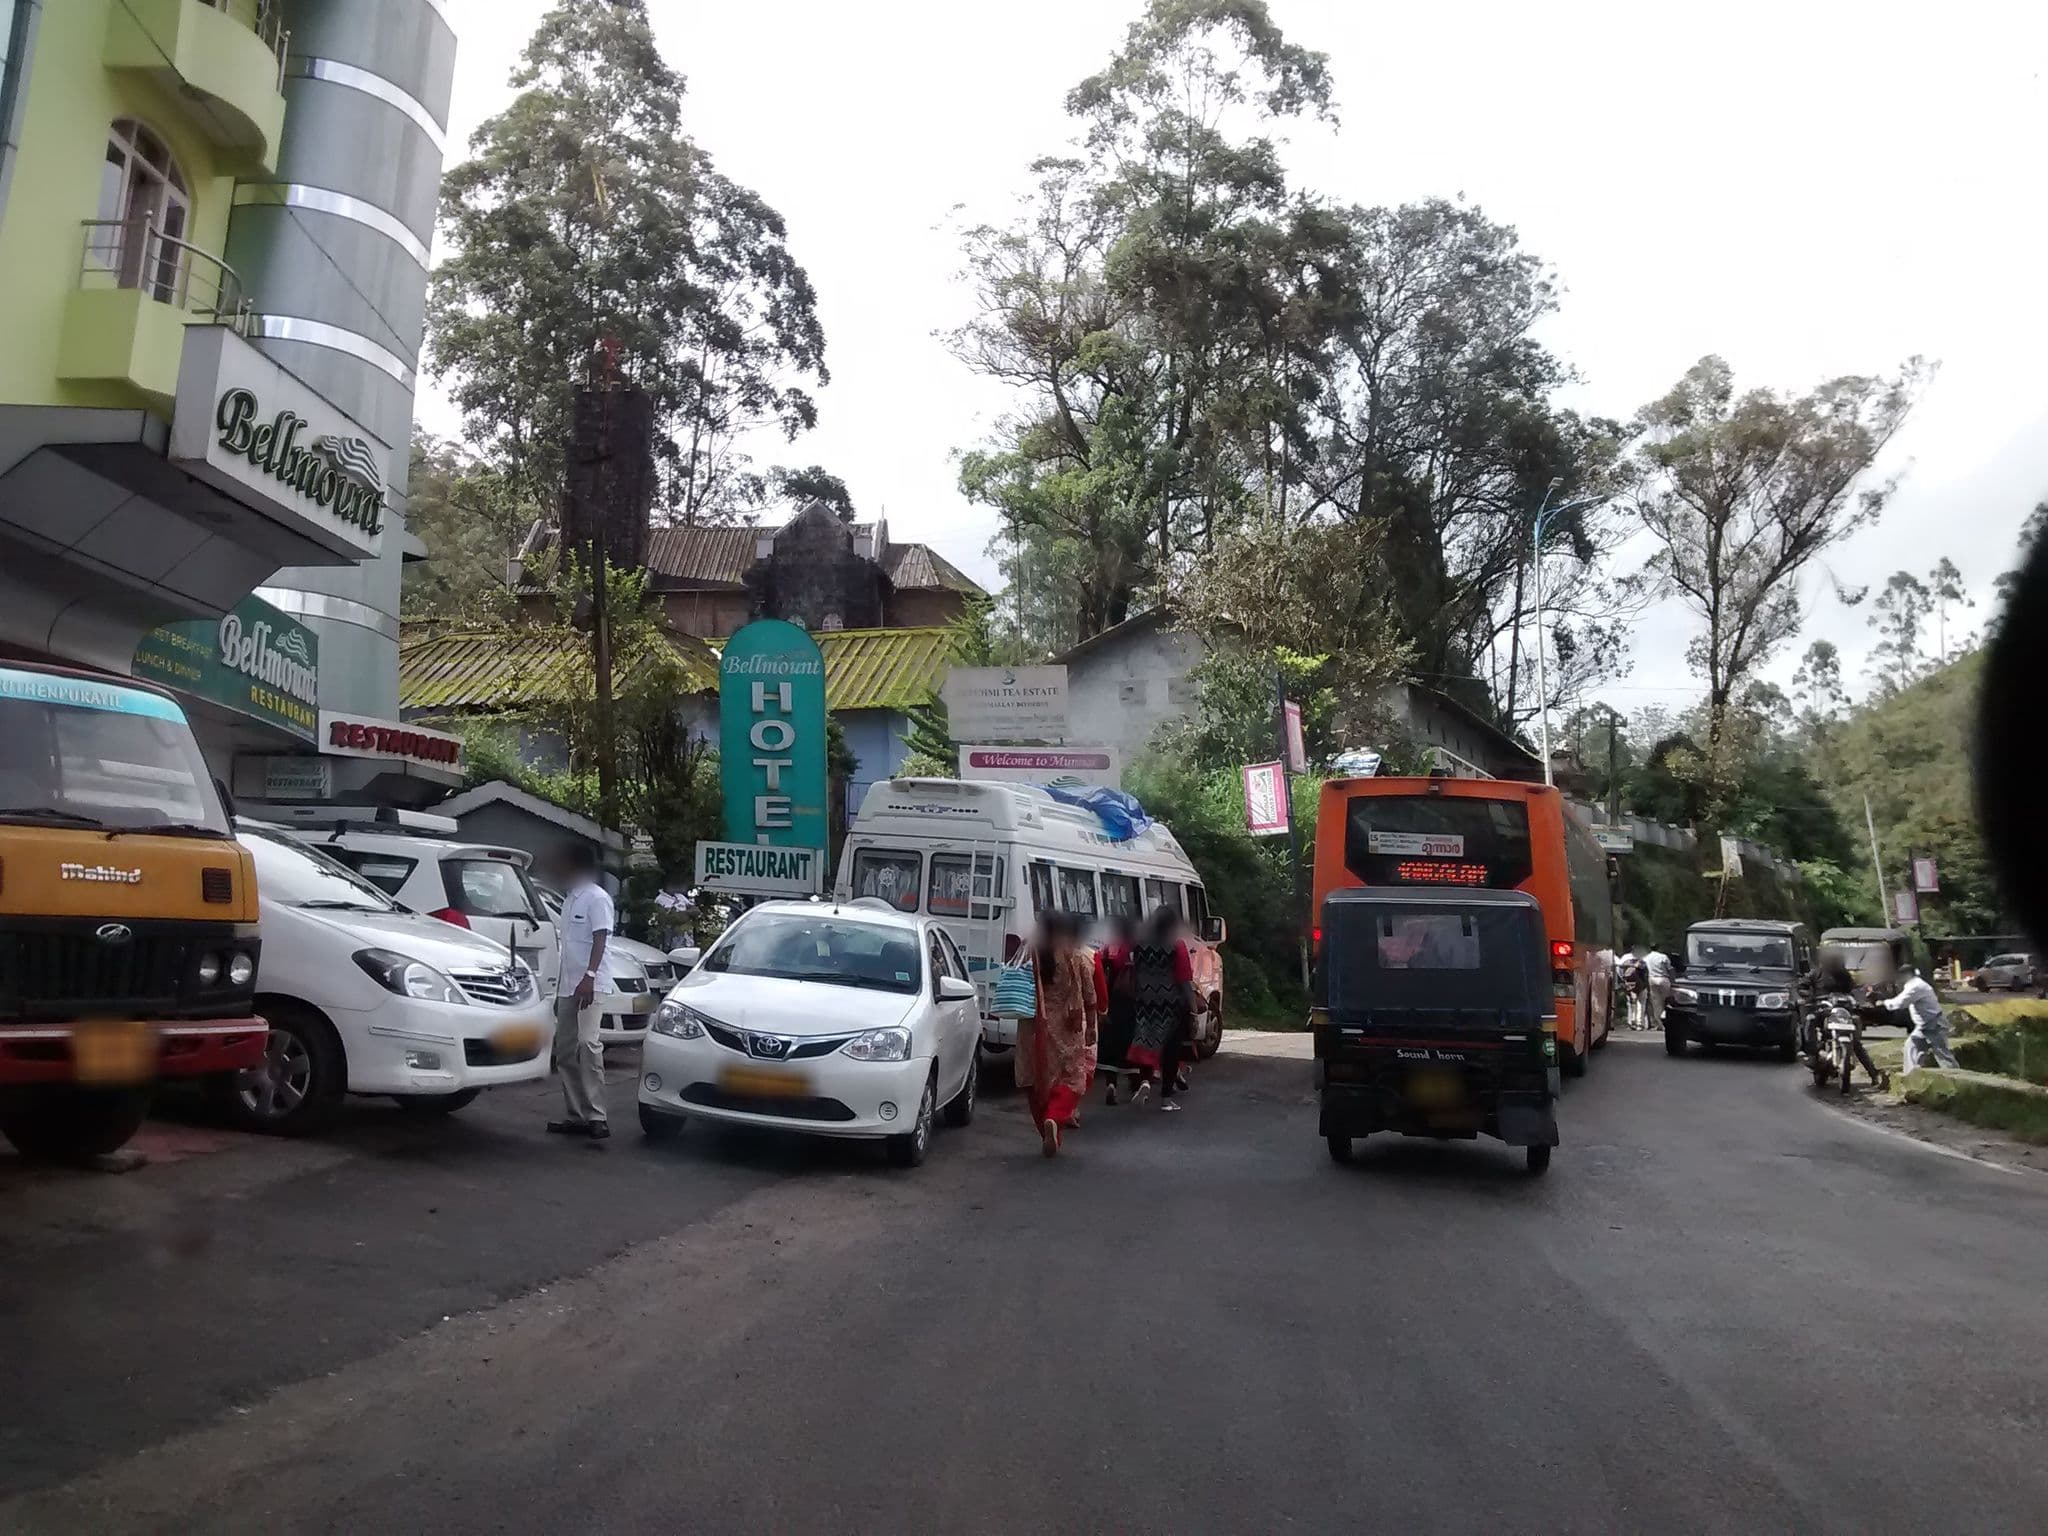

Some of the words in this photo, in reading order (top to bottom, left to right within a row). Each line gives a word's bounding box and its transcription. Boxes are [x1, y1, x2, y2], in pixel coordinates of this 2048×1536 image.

[216, 387, 385, 535] Bellmount
[219, 614, 317, 706] Bellmount
[723, 655, 820, 675] Bellmount
[251, 685, 316, 729] RESTAURANT
[1003, 688, 1021, 697] TEA
[1023, 687, 1059, 697] ESTATE
[329, 720, 462, 764] RESTAURANT
[982, 754, 1032, 766] Welcome
[1036, 755, 1047, 766] to
[705, 847, 811, 881] RESTAURANT
[1397, 1048, 1430, 1060] Sound
[1437, 1050, 1465, 1061] horn
